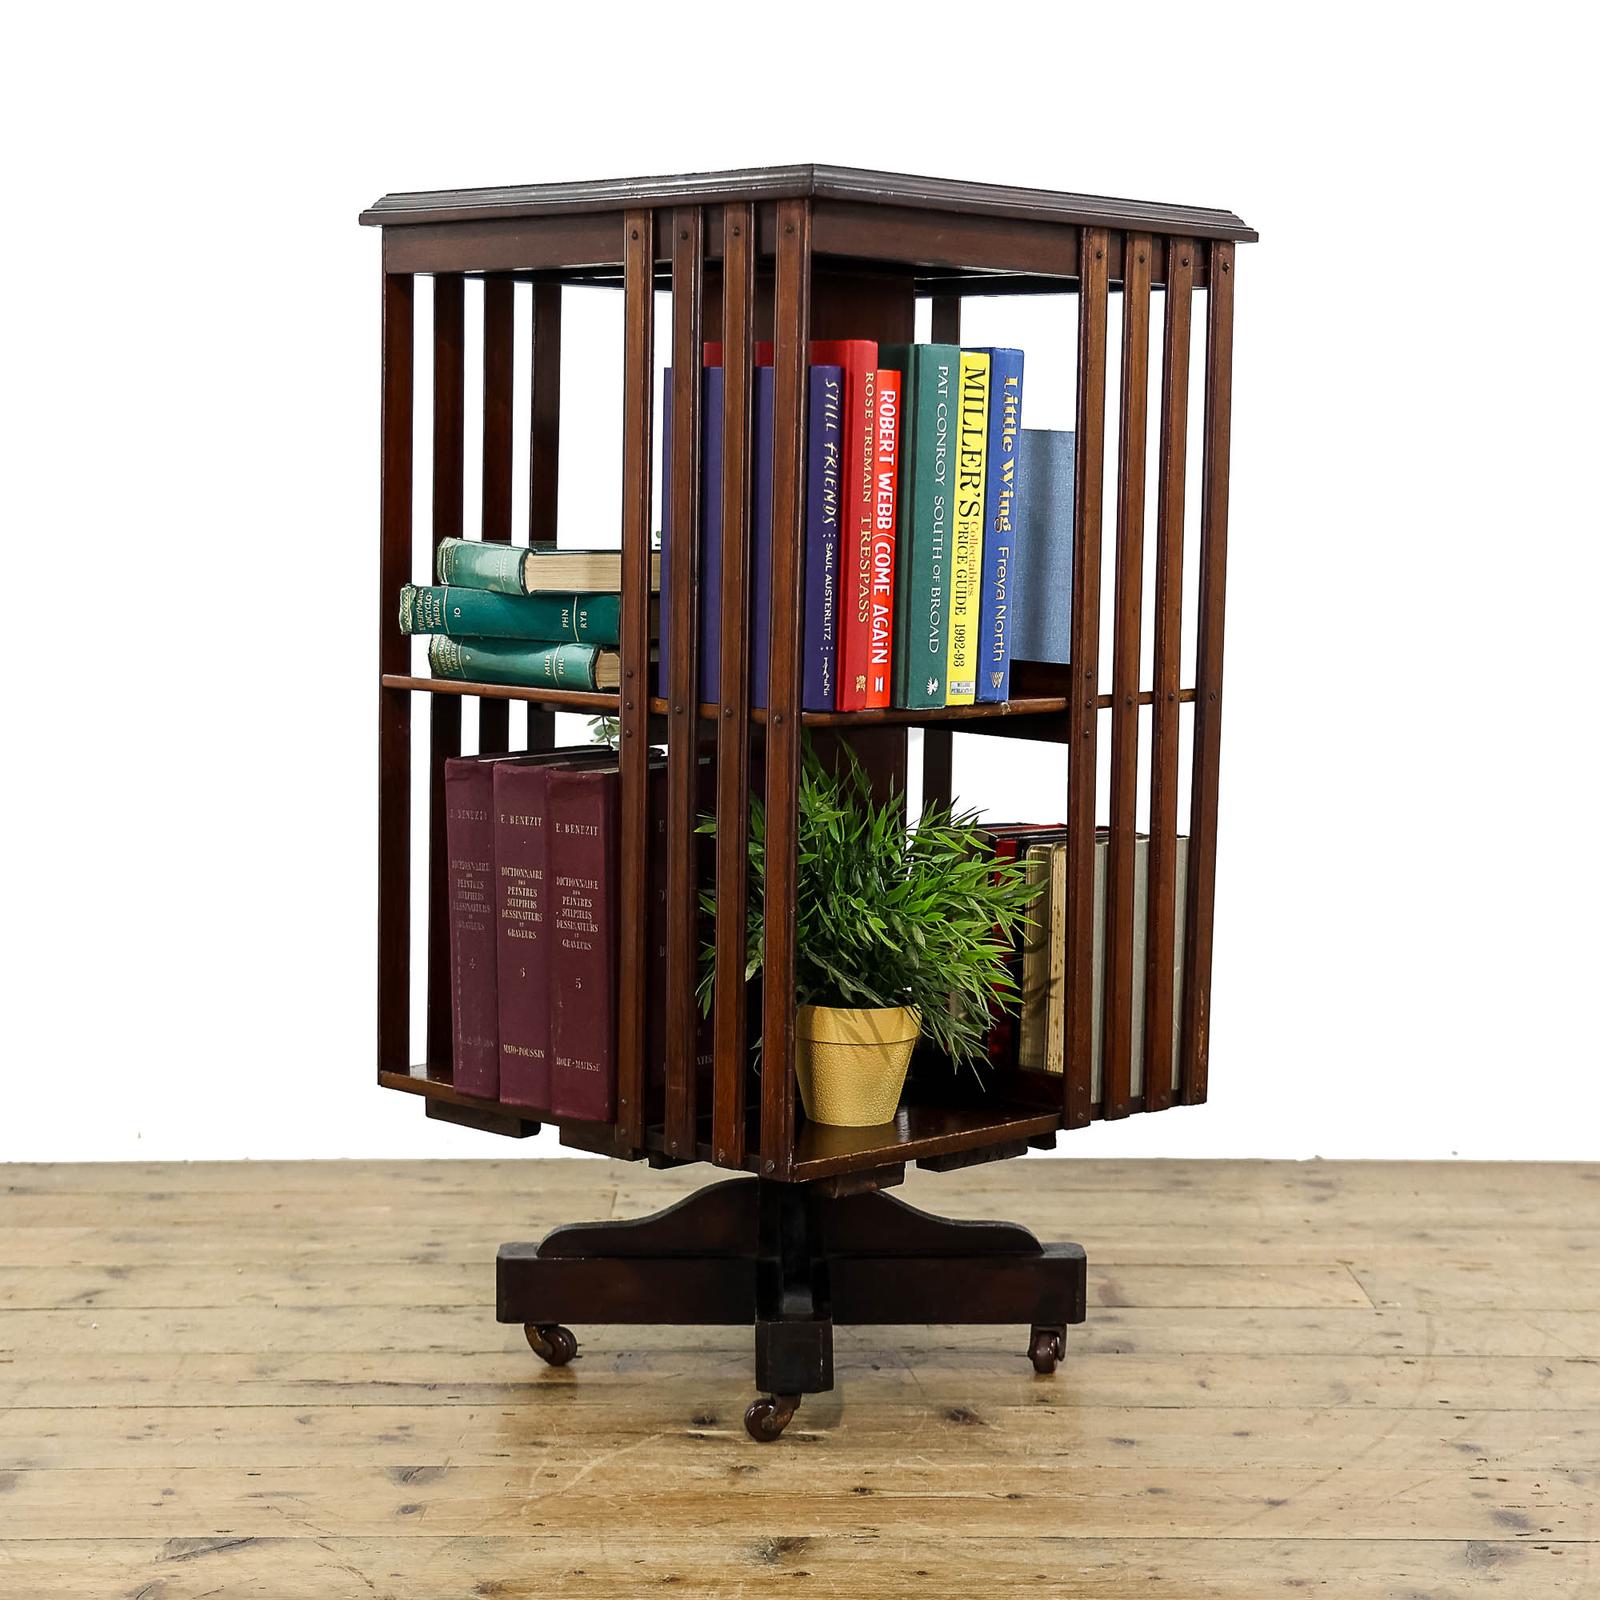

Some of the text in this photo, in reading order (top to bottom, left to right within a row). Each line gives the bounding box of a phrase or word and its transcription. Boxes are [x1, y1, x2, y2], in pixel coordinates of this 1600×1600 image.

[824, 378, 841, 432] STILL
[878, 390, 896, 465] ROBERT
[958, 366, 987, 517] MILLER'S
[993, 376, 1019, 533] Little Wing
[822, 442, 840, 527] FRIENDS
[858, 372, 874, 623] ROSE TREMAIN TRESPASS
[876, 472, 895, 530] WEBB
[929, 366, 949, 654] PAT CONROY SOUTH OF BROAD
[824, 543, 834, 573] SAUL
[957, 521, 969, 564] PRICE
[968, 521, 979, 596] Collectables
[823, 574, 834, 640] AUSTERLITZ
[955, 569, 968, 615] GUIDE
[992, 546, 1010, 662] Freya North
[953, 623, 966, 667] 1992-93
[509, 815, 542, 827] BENEZIT
[565, 823, 599, 837] BENEZIT
[501, 867, 544, 879] DICTIONNAIRE
[507, 886, 538, 898] PEINTRES
[562, 896, 592, 908] PEINTRES
[575, 976, 582, 989] 5
